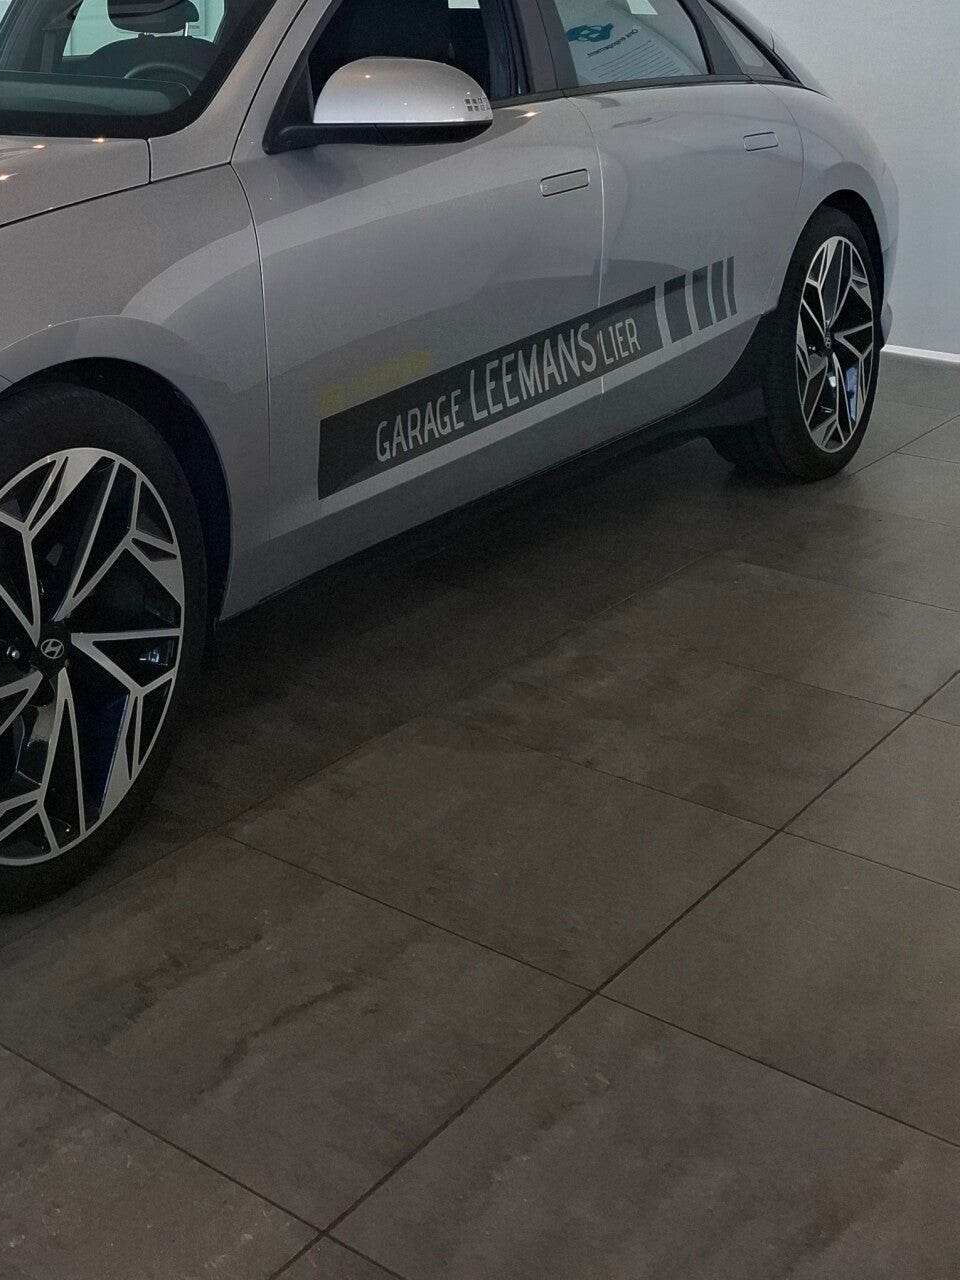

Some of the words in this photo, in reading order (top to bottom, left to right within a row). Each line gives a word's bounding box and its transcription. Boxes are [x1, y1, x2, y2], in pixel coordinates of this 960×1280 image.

[376, 389, 465, 463] GARAGE
[470, 322, 598, 422] LEEMANS
[597, 318, 641, 366] LIER
